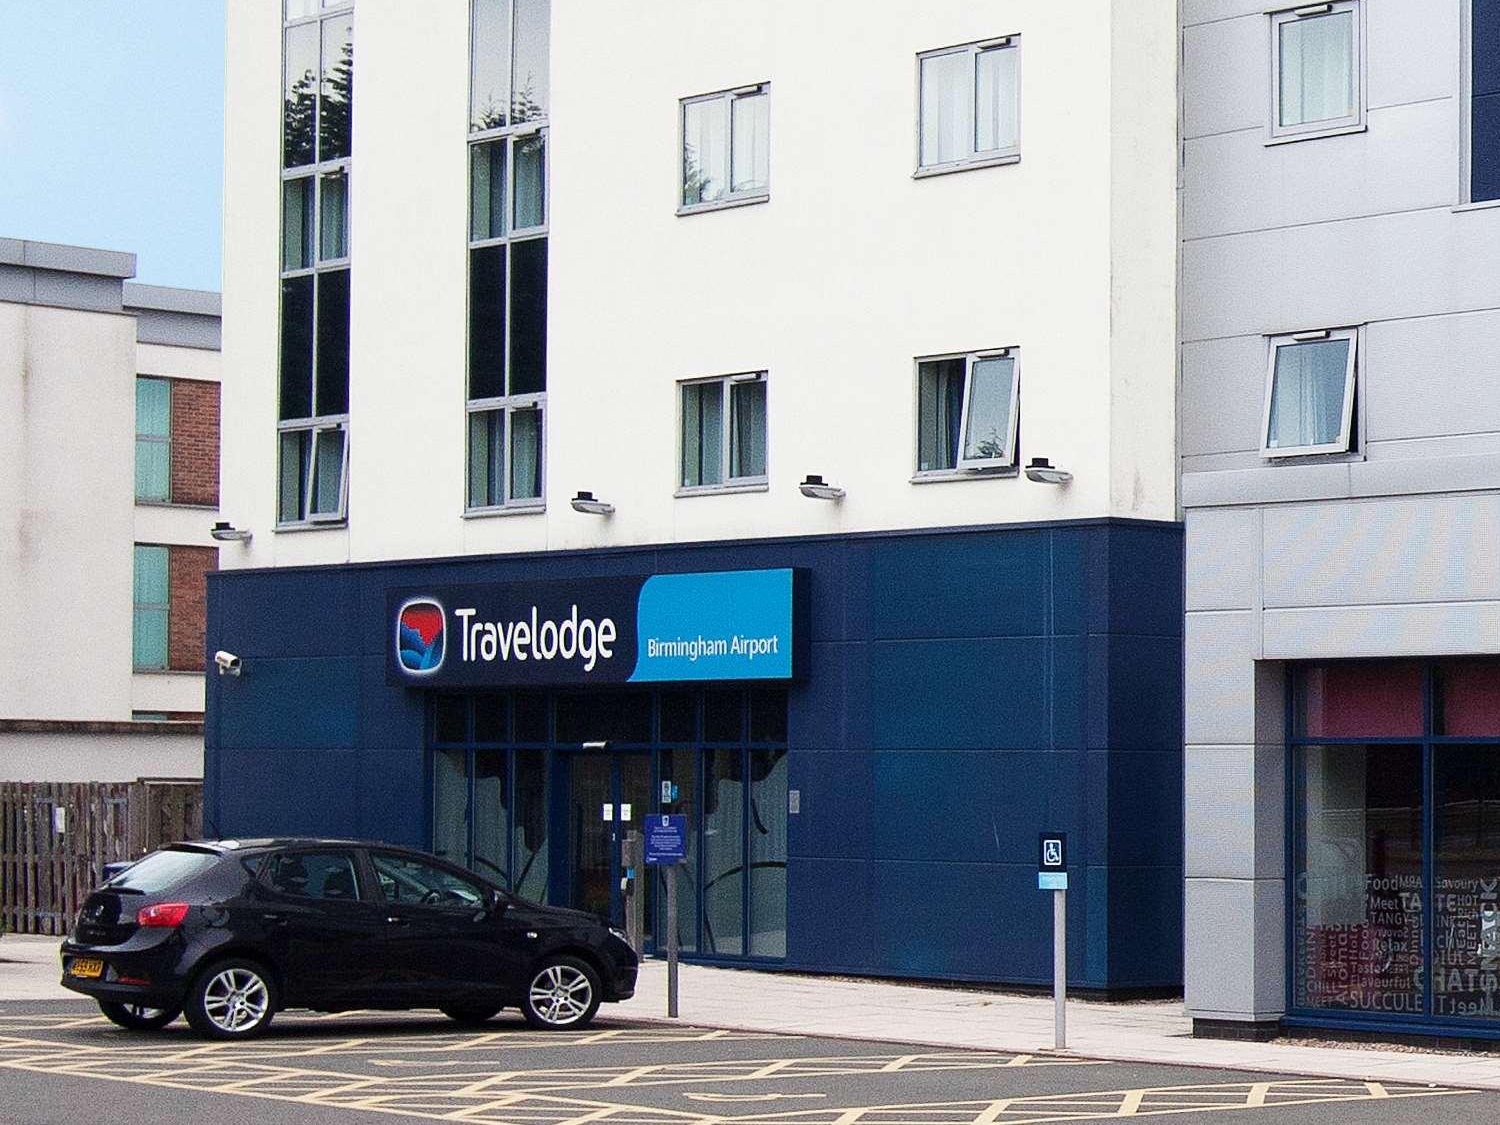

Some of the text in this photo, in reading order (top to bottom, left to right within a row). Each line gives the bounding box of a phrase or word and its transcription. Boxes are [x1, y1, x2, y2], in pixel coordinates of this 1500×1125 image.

[454, 605, 617, 672] Travelodge
[647, 634, 779, 661] Birmingham Airport
